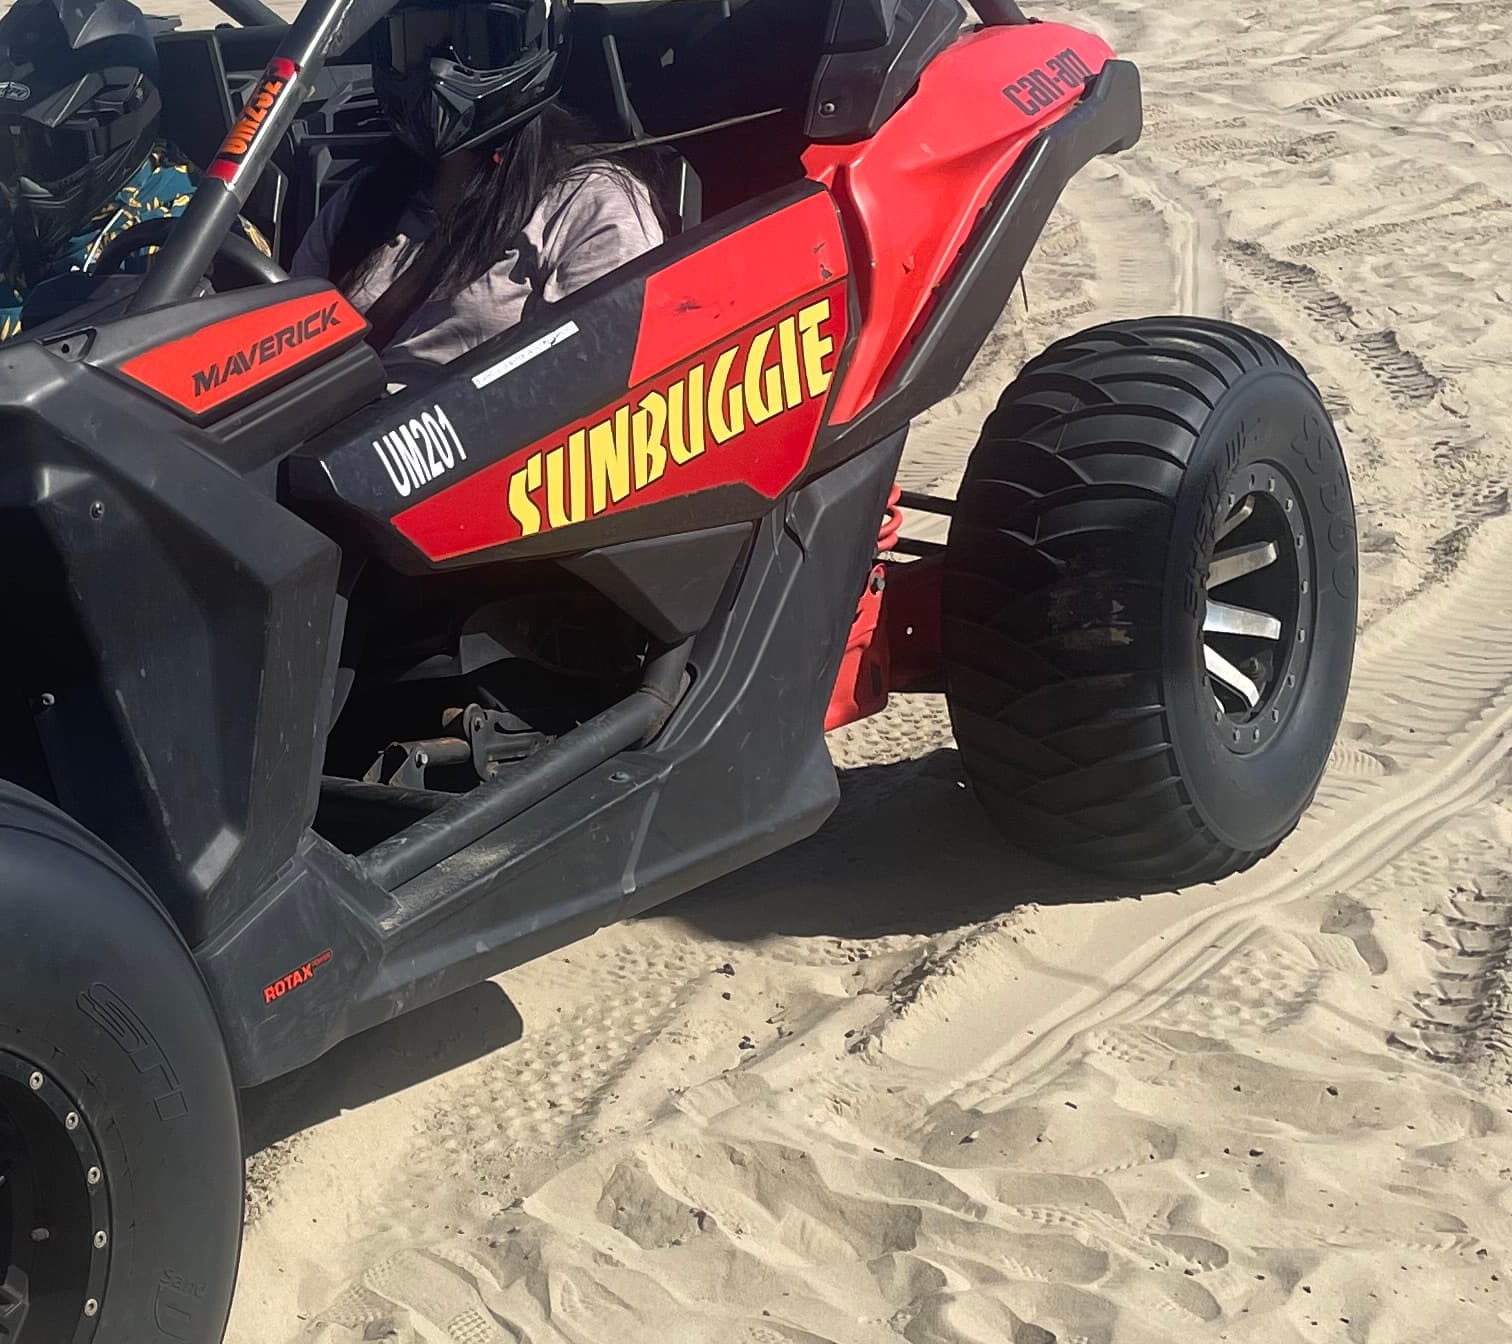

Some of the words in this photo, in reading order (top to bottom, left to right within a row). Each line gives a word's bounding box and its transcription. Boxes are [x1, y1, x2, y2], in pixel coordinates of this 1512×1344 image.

[1002, 47, 1093, 116] can-am
[192, 301, 342, 399] MAVERICK
[372, 404, 468, 498] UM201
[507, 296, 835, 537] SUNBUGGIE
[263, 963, 314, 1004] ROTAX
